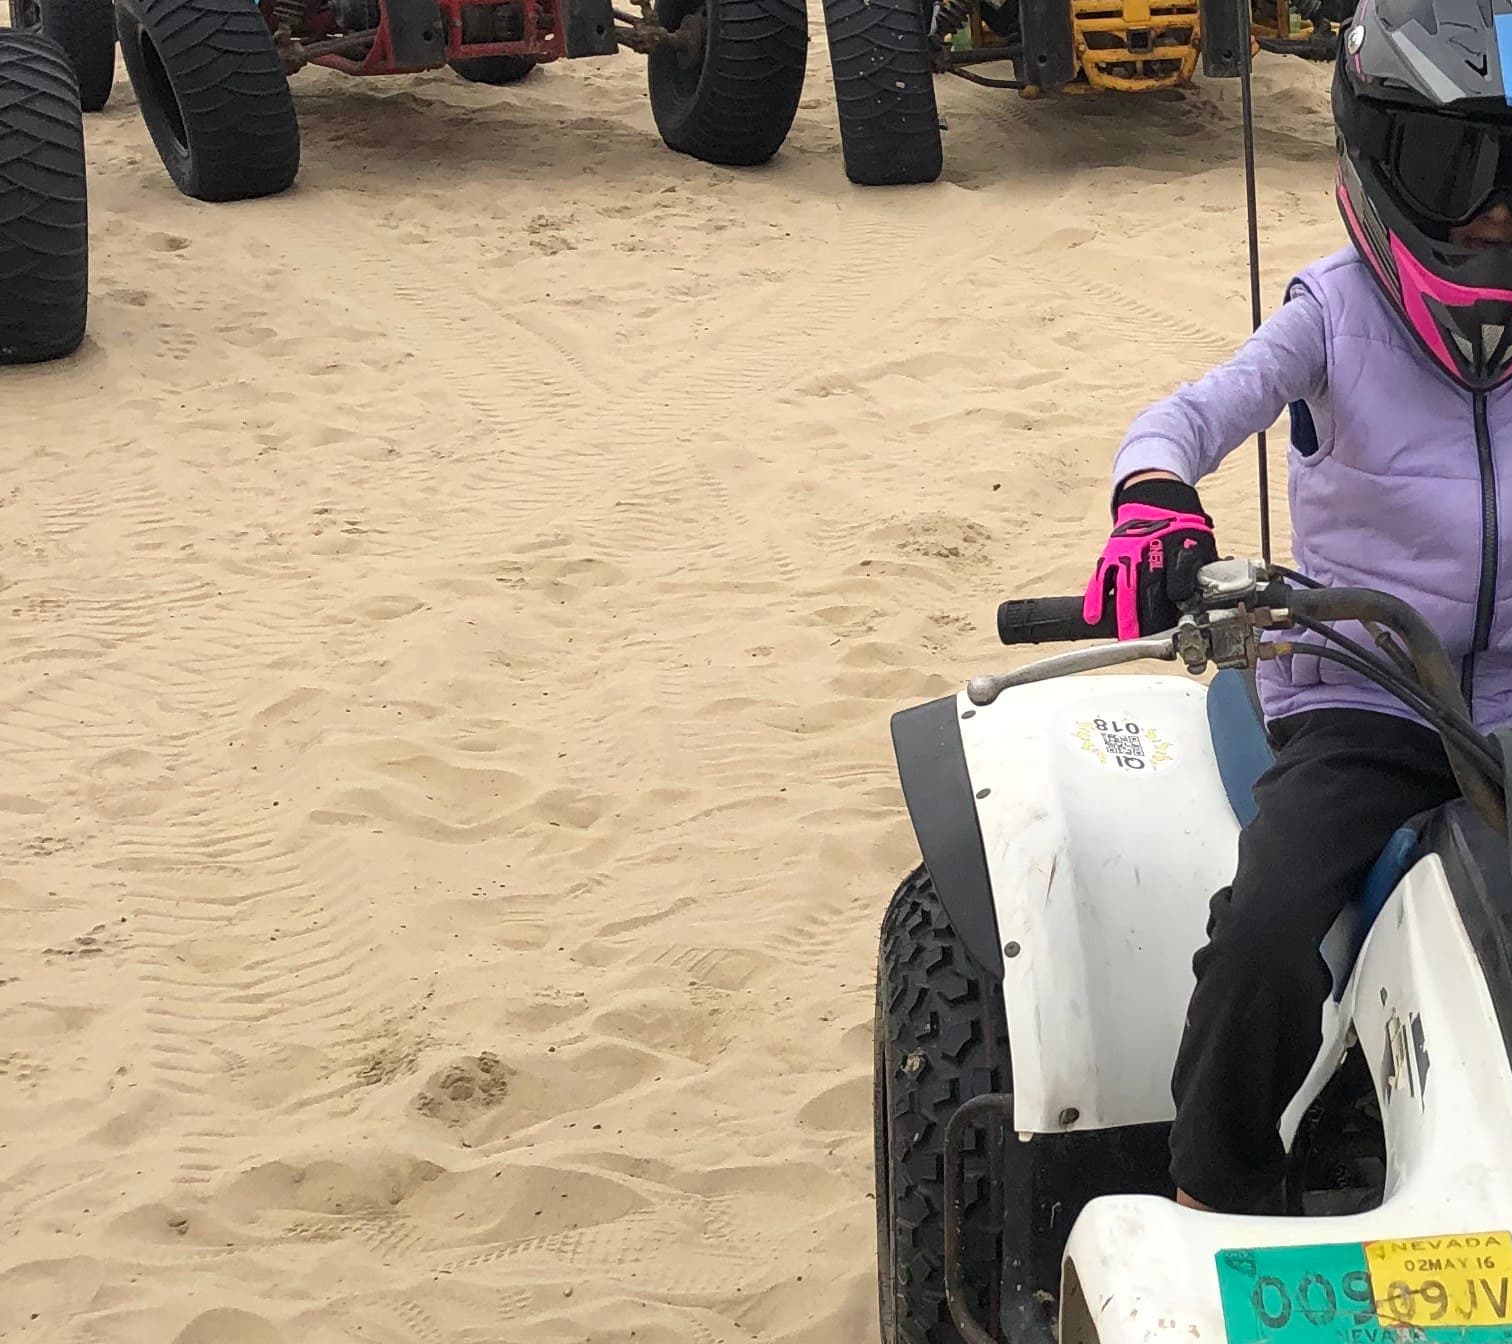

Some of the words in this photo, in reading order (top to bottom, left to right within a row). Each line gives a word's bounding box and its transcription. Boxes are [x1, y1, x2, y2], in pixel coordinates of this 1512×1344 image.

[1093, 718, 1140, 735] 018
[1390, 1235, 1502, 1253] NEVADA
[1404, 1256, 1471, 1272] 02MAY
[1477, 1255, 1496, 1270] 16
